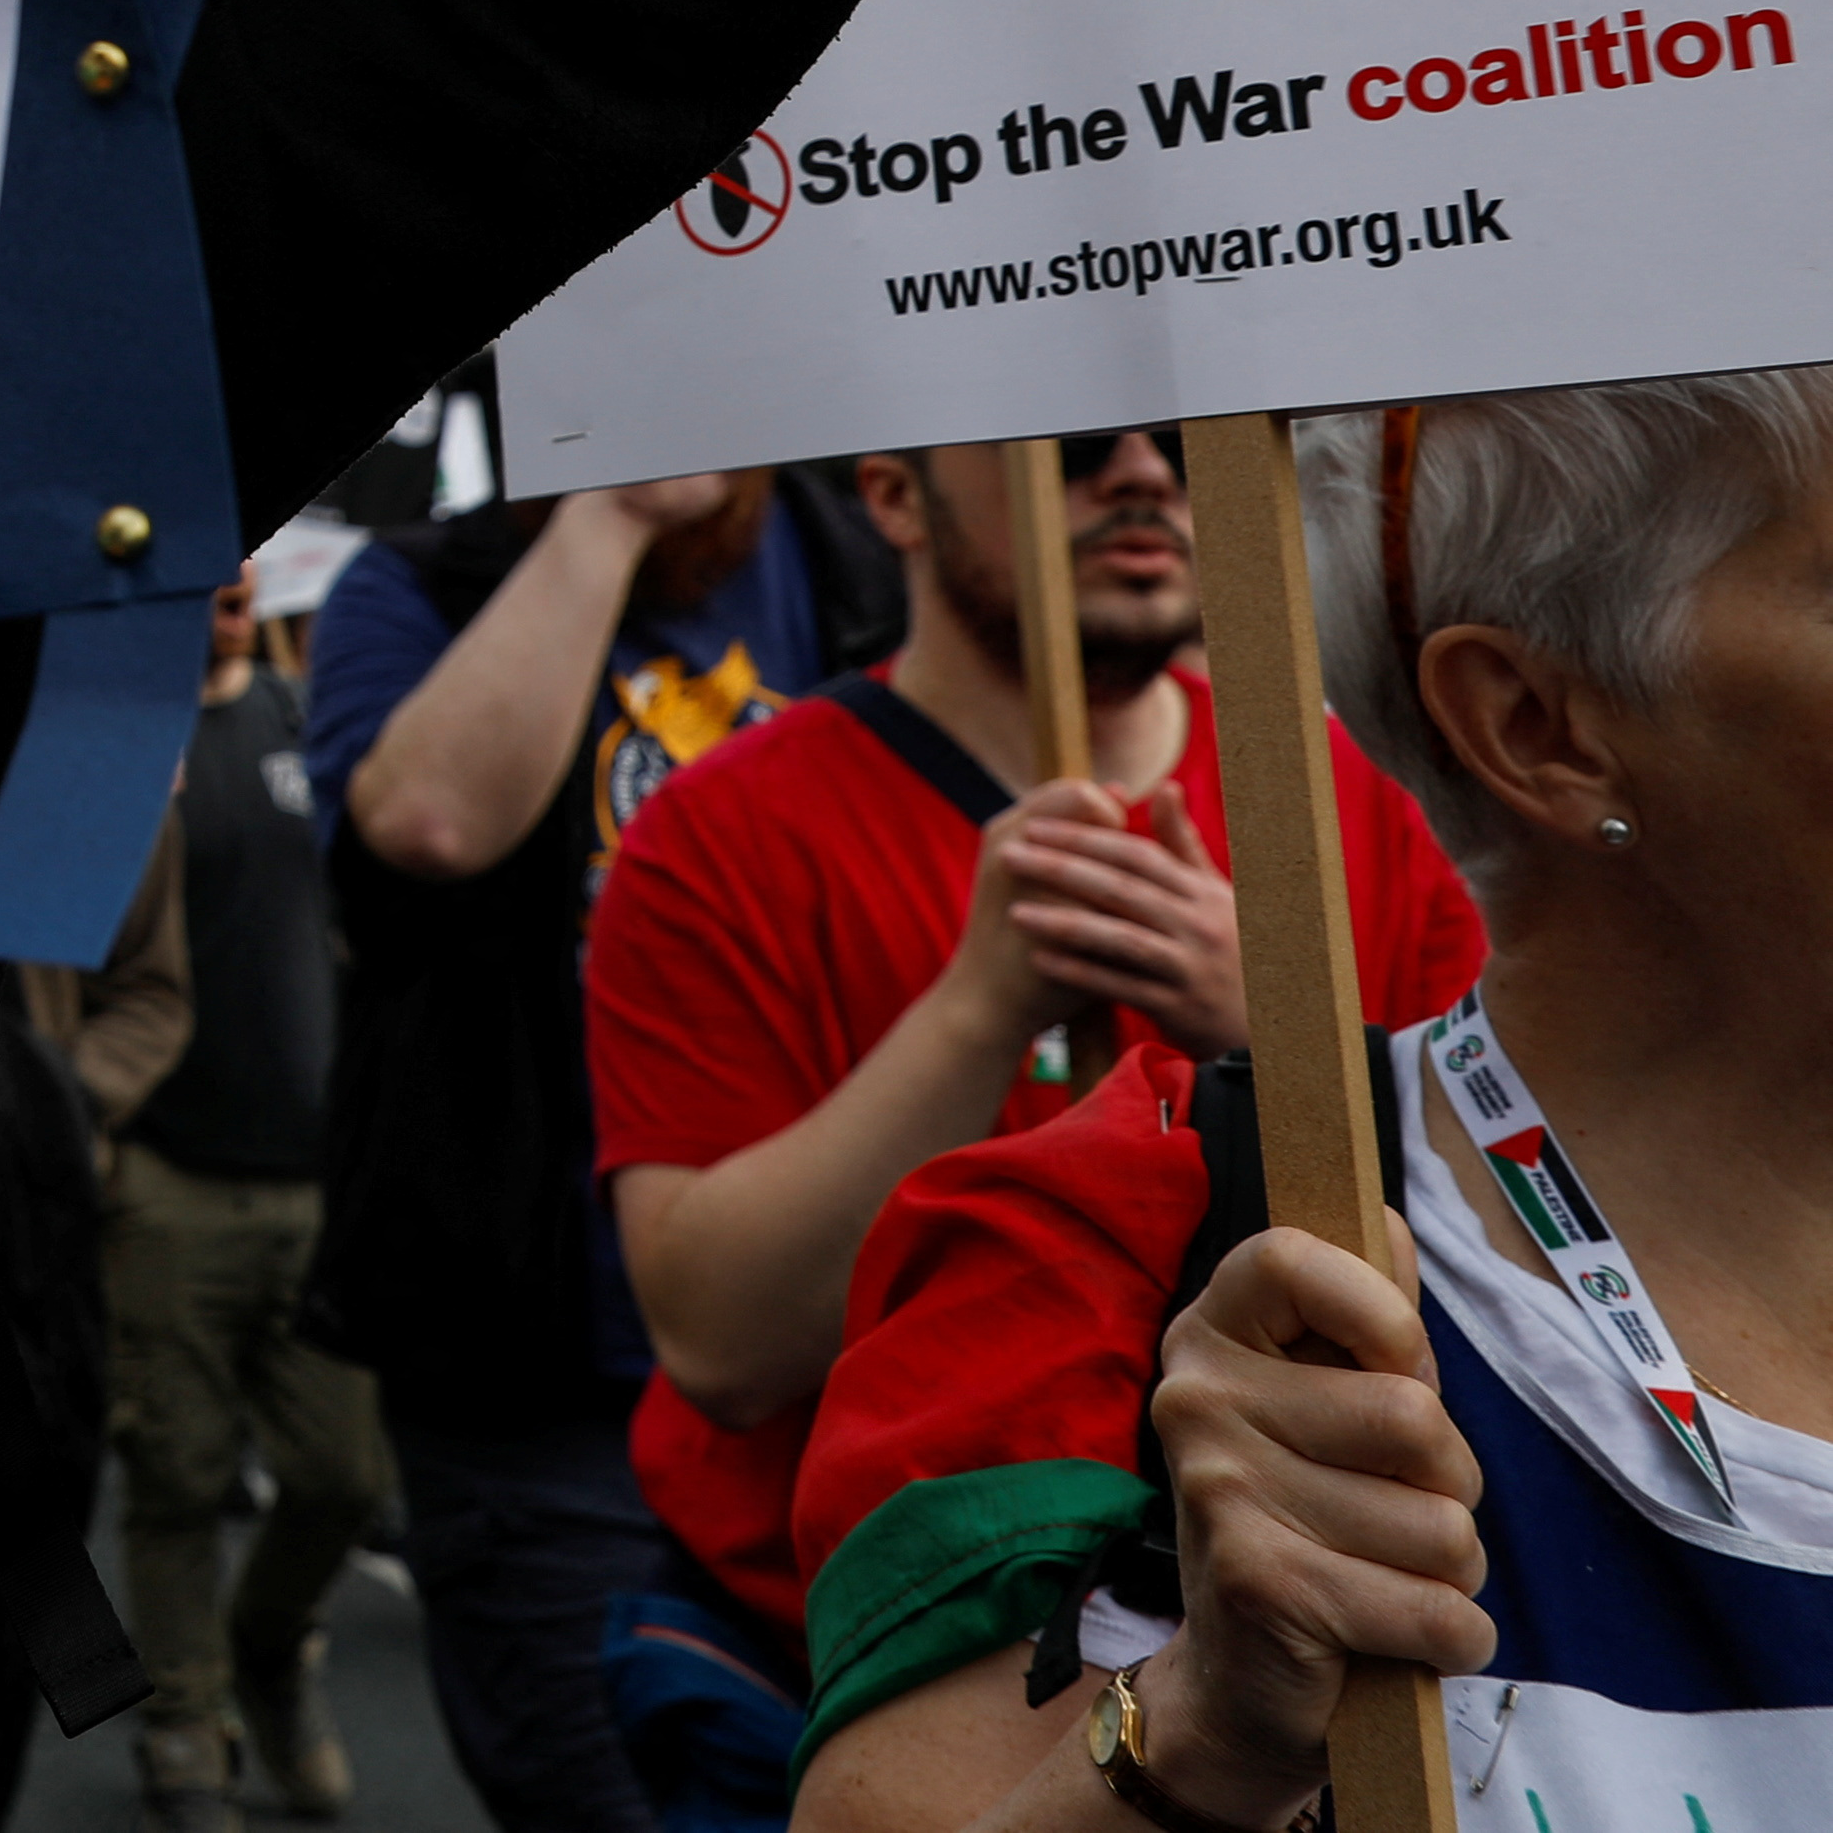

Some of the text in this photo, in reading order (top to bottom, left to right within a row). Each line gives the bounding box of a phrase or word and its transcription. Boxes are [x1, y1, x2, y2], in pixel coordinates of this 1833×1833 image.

[799, 10, 1795, 204] Stop the War coalition
[886, 189, 1510, 315] www.stopwar.org.uk
[1530, 1171, 1585, 1243] PALESTINE
